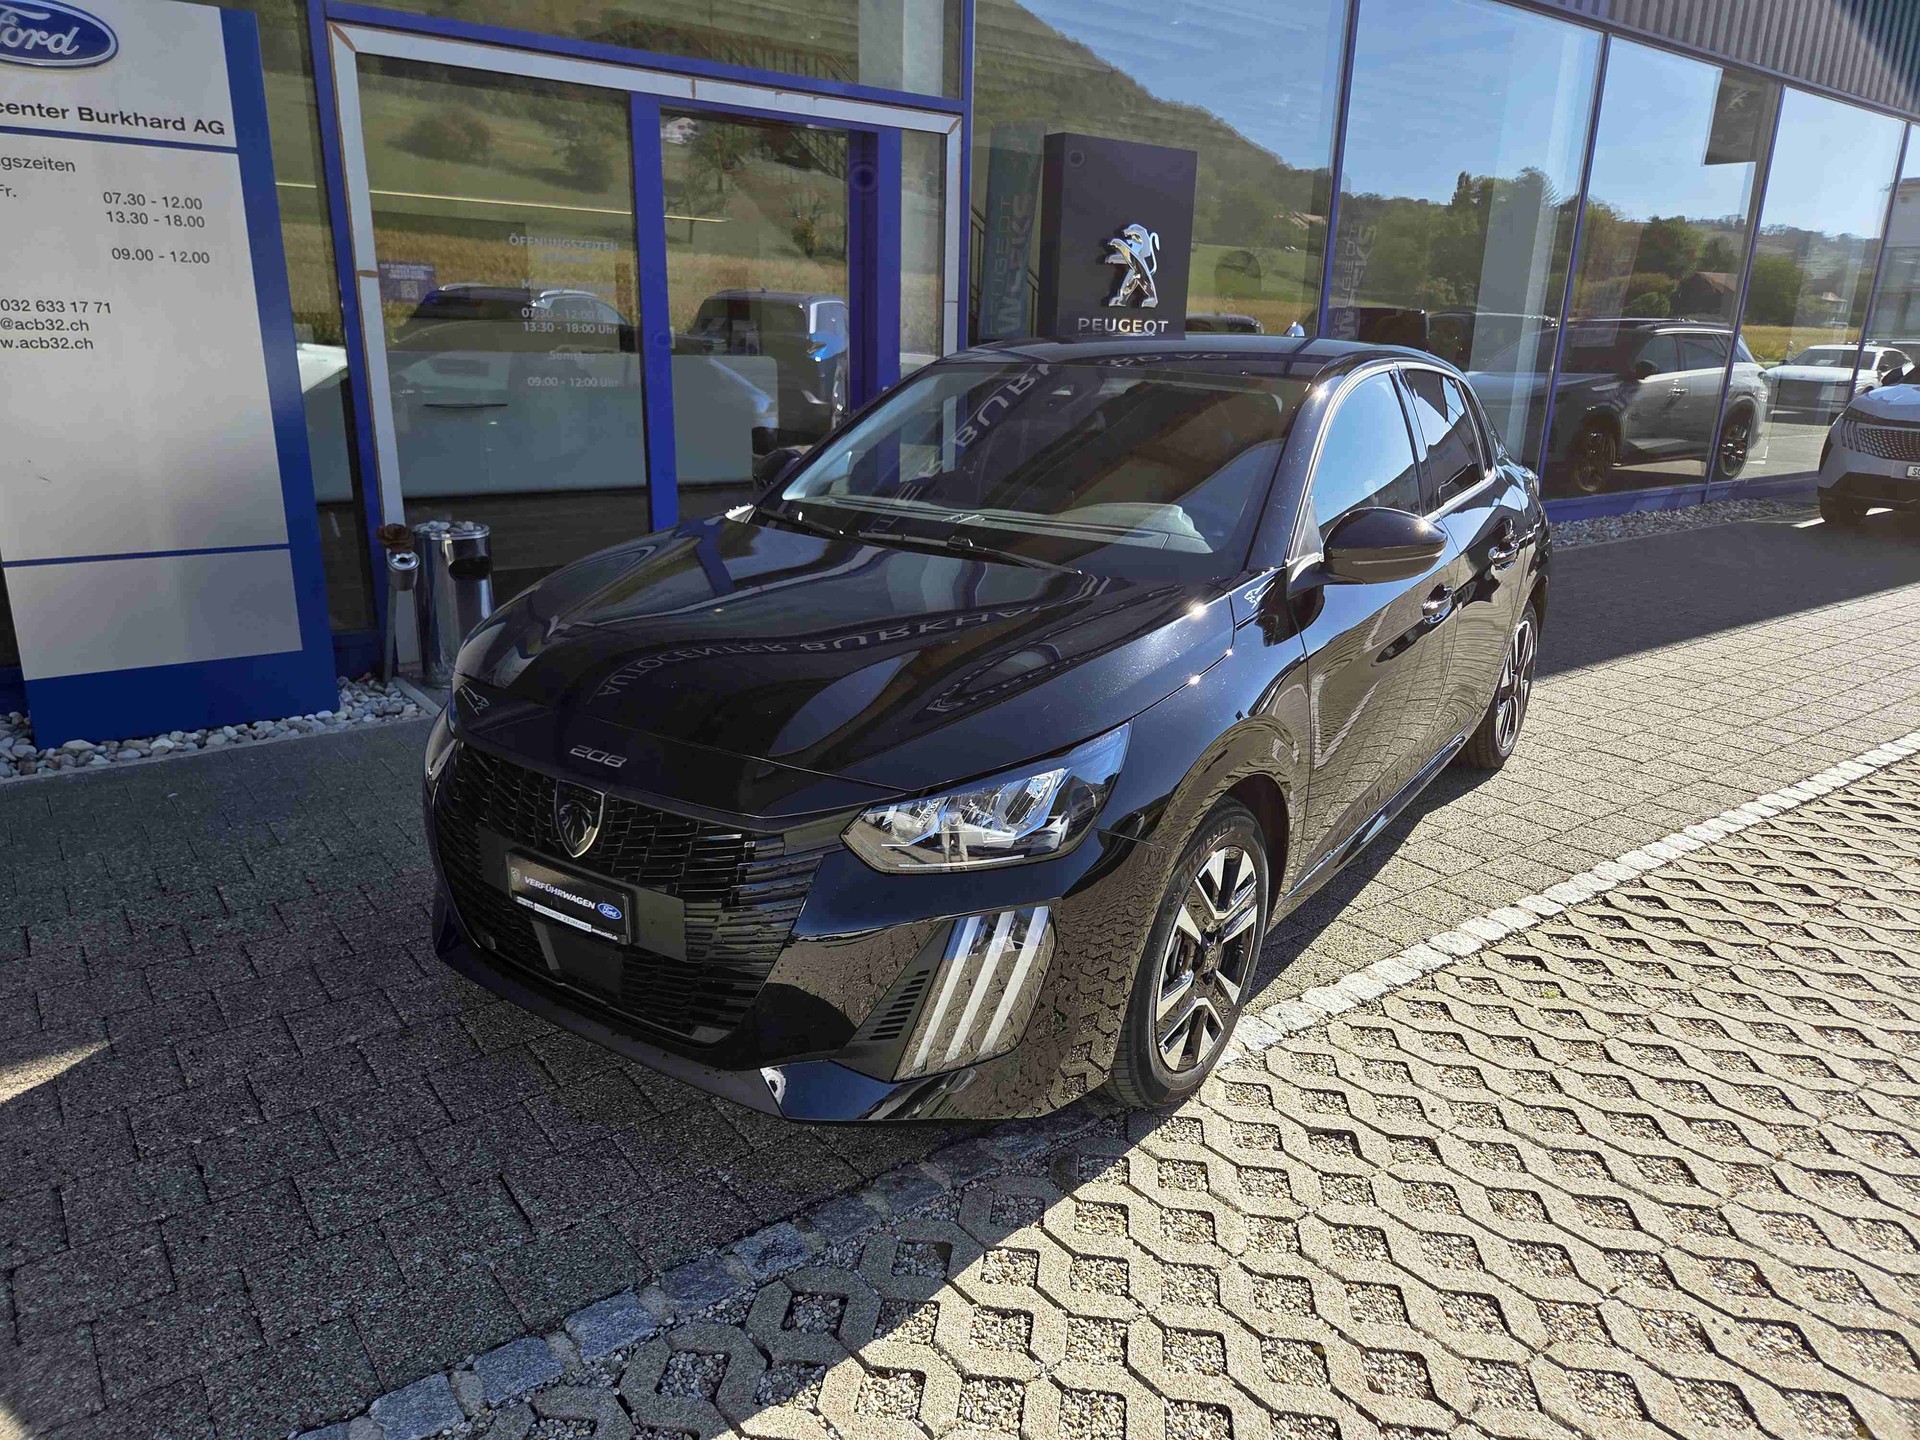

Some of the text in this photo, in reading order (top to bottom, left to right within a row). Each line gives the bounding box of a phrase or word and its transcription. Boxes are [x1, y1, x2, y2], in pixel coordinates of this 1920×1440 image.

[78, 106, 186, 131] Burkhard
[193, 119, 225, 135] AG
[103, 191, 146, 207] 07.30
[162, 196, 203, 210] 12.00
[106, 211, 149, 225] 13.30
[164, 214, 205, 228] 18.00
[111, 247, 154, 262] 09.00
[170, 251, 210, 264] 12.00
[0, 299, 111, 314] 032 633 17 71
[523, 321, 555, 333] 13:30
[565, 323, 596, 334] 18:00
[598, 324, 619, 335] Uhr
[1077, 317, 1169, 334] PEUGEOT
[527, 376, 558, 387] 09:00
[570, 378, 598, 388] 12:00
[569, 744, 628, 768] 208
[524, 875, 596, 910] VERFÜHRWAGEN
[600, 904, 620, 919] Ford
